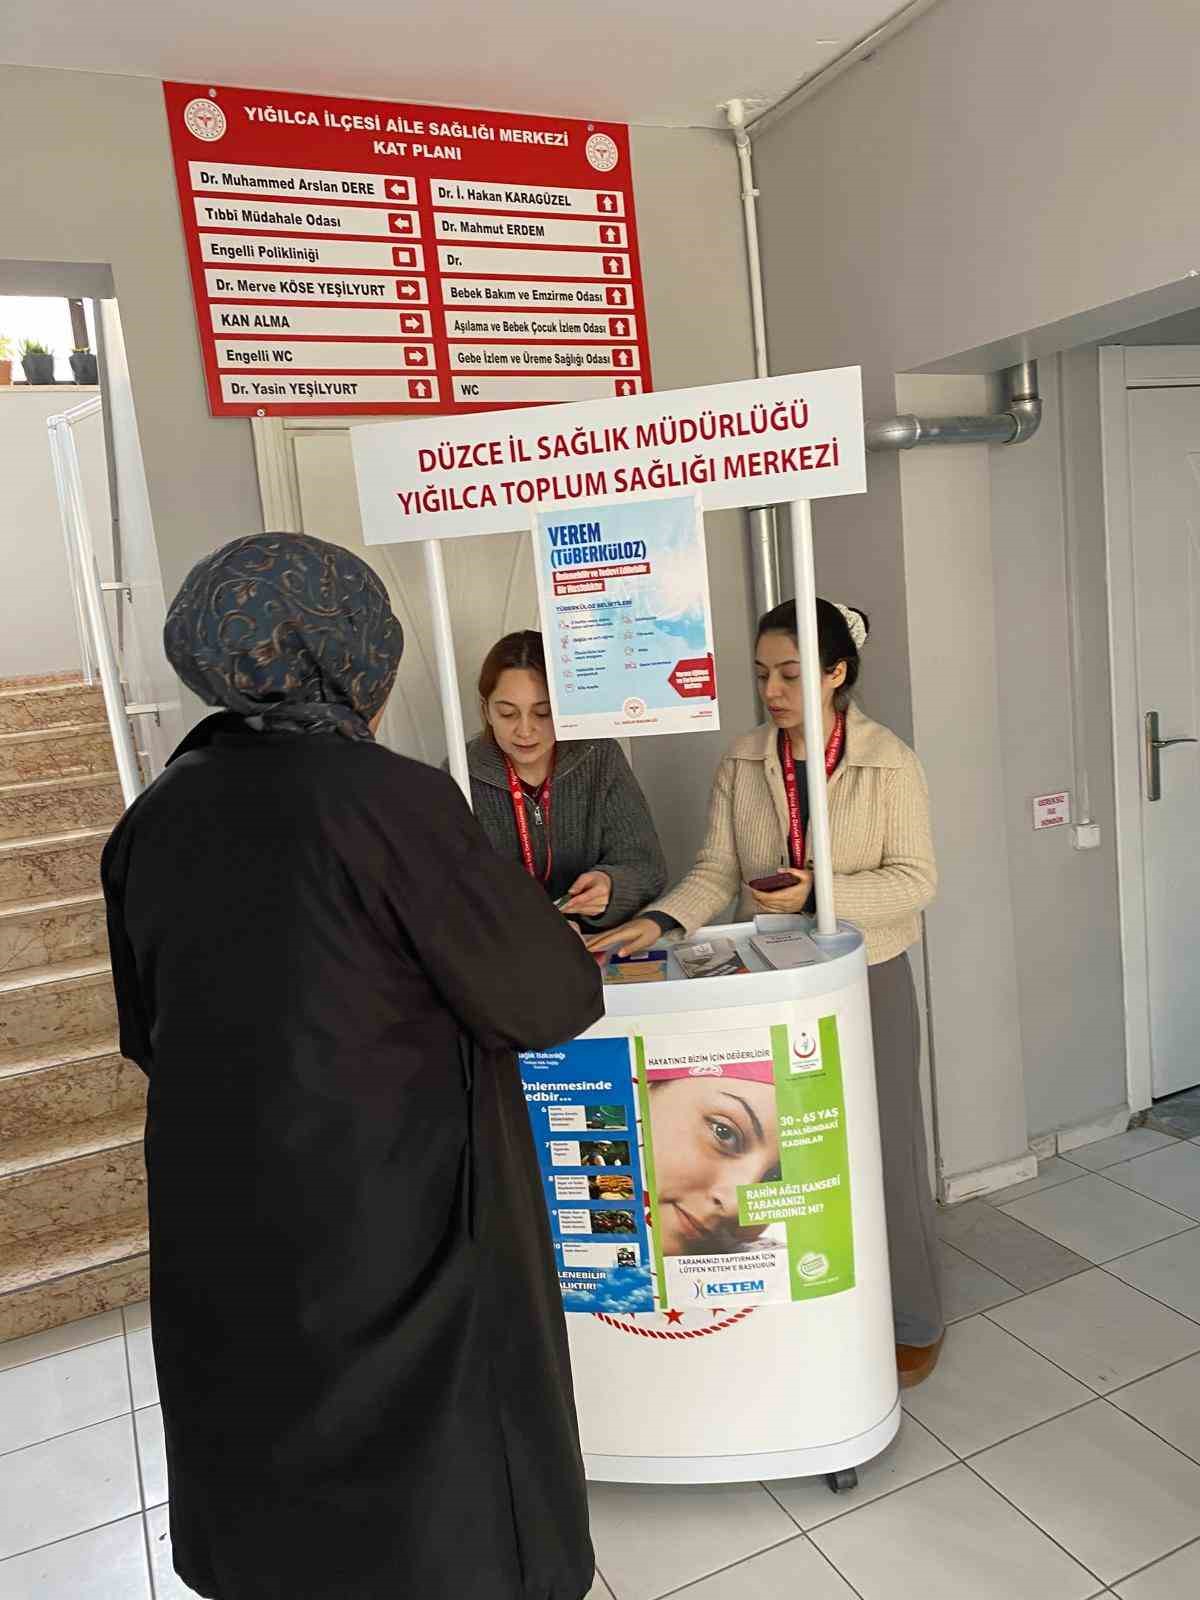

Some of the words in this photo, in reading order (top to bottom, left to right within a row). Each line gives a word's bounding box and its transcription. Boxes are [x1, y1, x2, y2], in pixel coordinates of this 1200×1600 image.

[243, 105, 319, 127] YIĞILCA
[324, 109, 381, 132] İLÇESİ
[386, 116, 425, 135] AİLE
[429, 121, 494, 142] SAĞLIĞI
[499, 128, 569, 147] MERKEZİ
[373, 140, 407, 156] KAT
[412, 143, 462, 161] PLANI
[200, 171, 219, 185] Dr.
[222, 172, 295, 190] Muhammed
[299, 178, 338, 193] Arslan
[341, 182, 375, 195] DERE
[438, 186, 454, 199] Dr.
[456, 186, 464, 200] İ.
[467, 188, 502, 203] Hakan
[504, 190, 571, 206] KARAGÜZEL
[242, 209, 303, 225] Müdahale
[306, 213, 341, 227] Odası
[441, 219, 457, 232] Dr.
[460, 220, 504, 235] Mahmut
[507, 223, 545, 237] ERDEM
[211, 243, 255, 260] Engelli
[258, 246, 320, 263] Polikliniği
[447, 254, 463, 267] Dr.
[216, 278, 234, 292] Dr.
[237, 279, 276, 293] Merve
[280, 279, 314, 294] KÖSE
[318, 281, 386, 297] YEŞİLYURT
[450, 287, 482, 299] Bebek
[485, 288, 516, 300] Bakım
[518, 291, 530, 301] ve
[532, 289, 574, 301] Emzirme
[576, 290, 603, 302] Odası
[221, 313, 250, 327] KAN
[254, 314, 290, 328] ALMA
[454, 320, 489, 334] Aşılama
[490, 323, 501, 332] ve
[503, 321, 529, 333] Bebek
[531, 321, 558, 335] Çocuk
[559, 320, 581, 333] İzlem
[583, 322, 606, 334] Odası
[226, 349, 269, 365] Engelli
[272, 350, 293, 362] WC
[458, 353, 481, 364] Gebe
[483, 351, 508, 364] İzlem
[510, 355, 522, 364] ve
[523, 351, 552, 364] Üreme
[554, 353, 584, 367] Sağlığı
[586, 354, 610, 365] Odası
[231, 382, 249, 395] Dr.
[252, 382, 286, 395] Yasin
[289, 380, 358, 397] YEŞİLYURT
[461, 384, 480, 396] WC
[418, 441, 504, 473] DÜZCE
[509, 434, 531, 463] İL
[537, 426, 630, 461] SAĞLIK
[636, 398, 809, 449] MÜDÜRLÜĞÜ
[397, 484, 497, 515] YIĞILCA
[500, 471, 607, 506] TOPLUM
[614, 454, 716, 494] SAĞLIĞI
[723, 437, 839, 480] MERKEZİ
[547, 522, 601, 547] VEREM
[551, 540, 647, 569] (TÜBERKÜLOZ)
[648, 1056, 686, 1066] HAYATINIZ
[688, 1053, 709, 1063] BİZİM
[710, 1051, 725, 1062] İÇİN
[727, 1048, 770, 1060] DEĞERLİDİR
[525, 1091, 572, 1102] edbir...
[780, 1115, 794, 1126] 30
[803, 1111, 816, 1123] 65
[746, 1186, 777, 1200] RAHİM
[802, 1174, 840, 1193] KANSERİ
[747, 1195, 805, 1211] TARAMANIZI
[748, 1206, 807, 1221] YAPTIRDINIZ
[678, 1257, 719, 1265] TARAMANIZI
[680, 1264, 706, 1274] LÜTFEN
[558, 1270, 606, 1279] LENEBİLİR
[706, 1279, 765, 1293] KETEM
